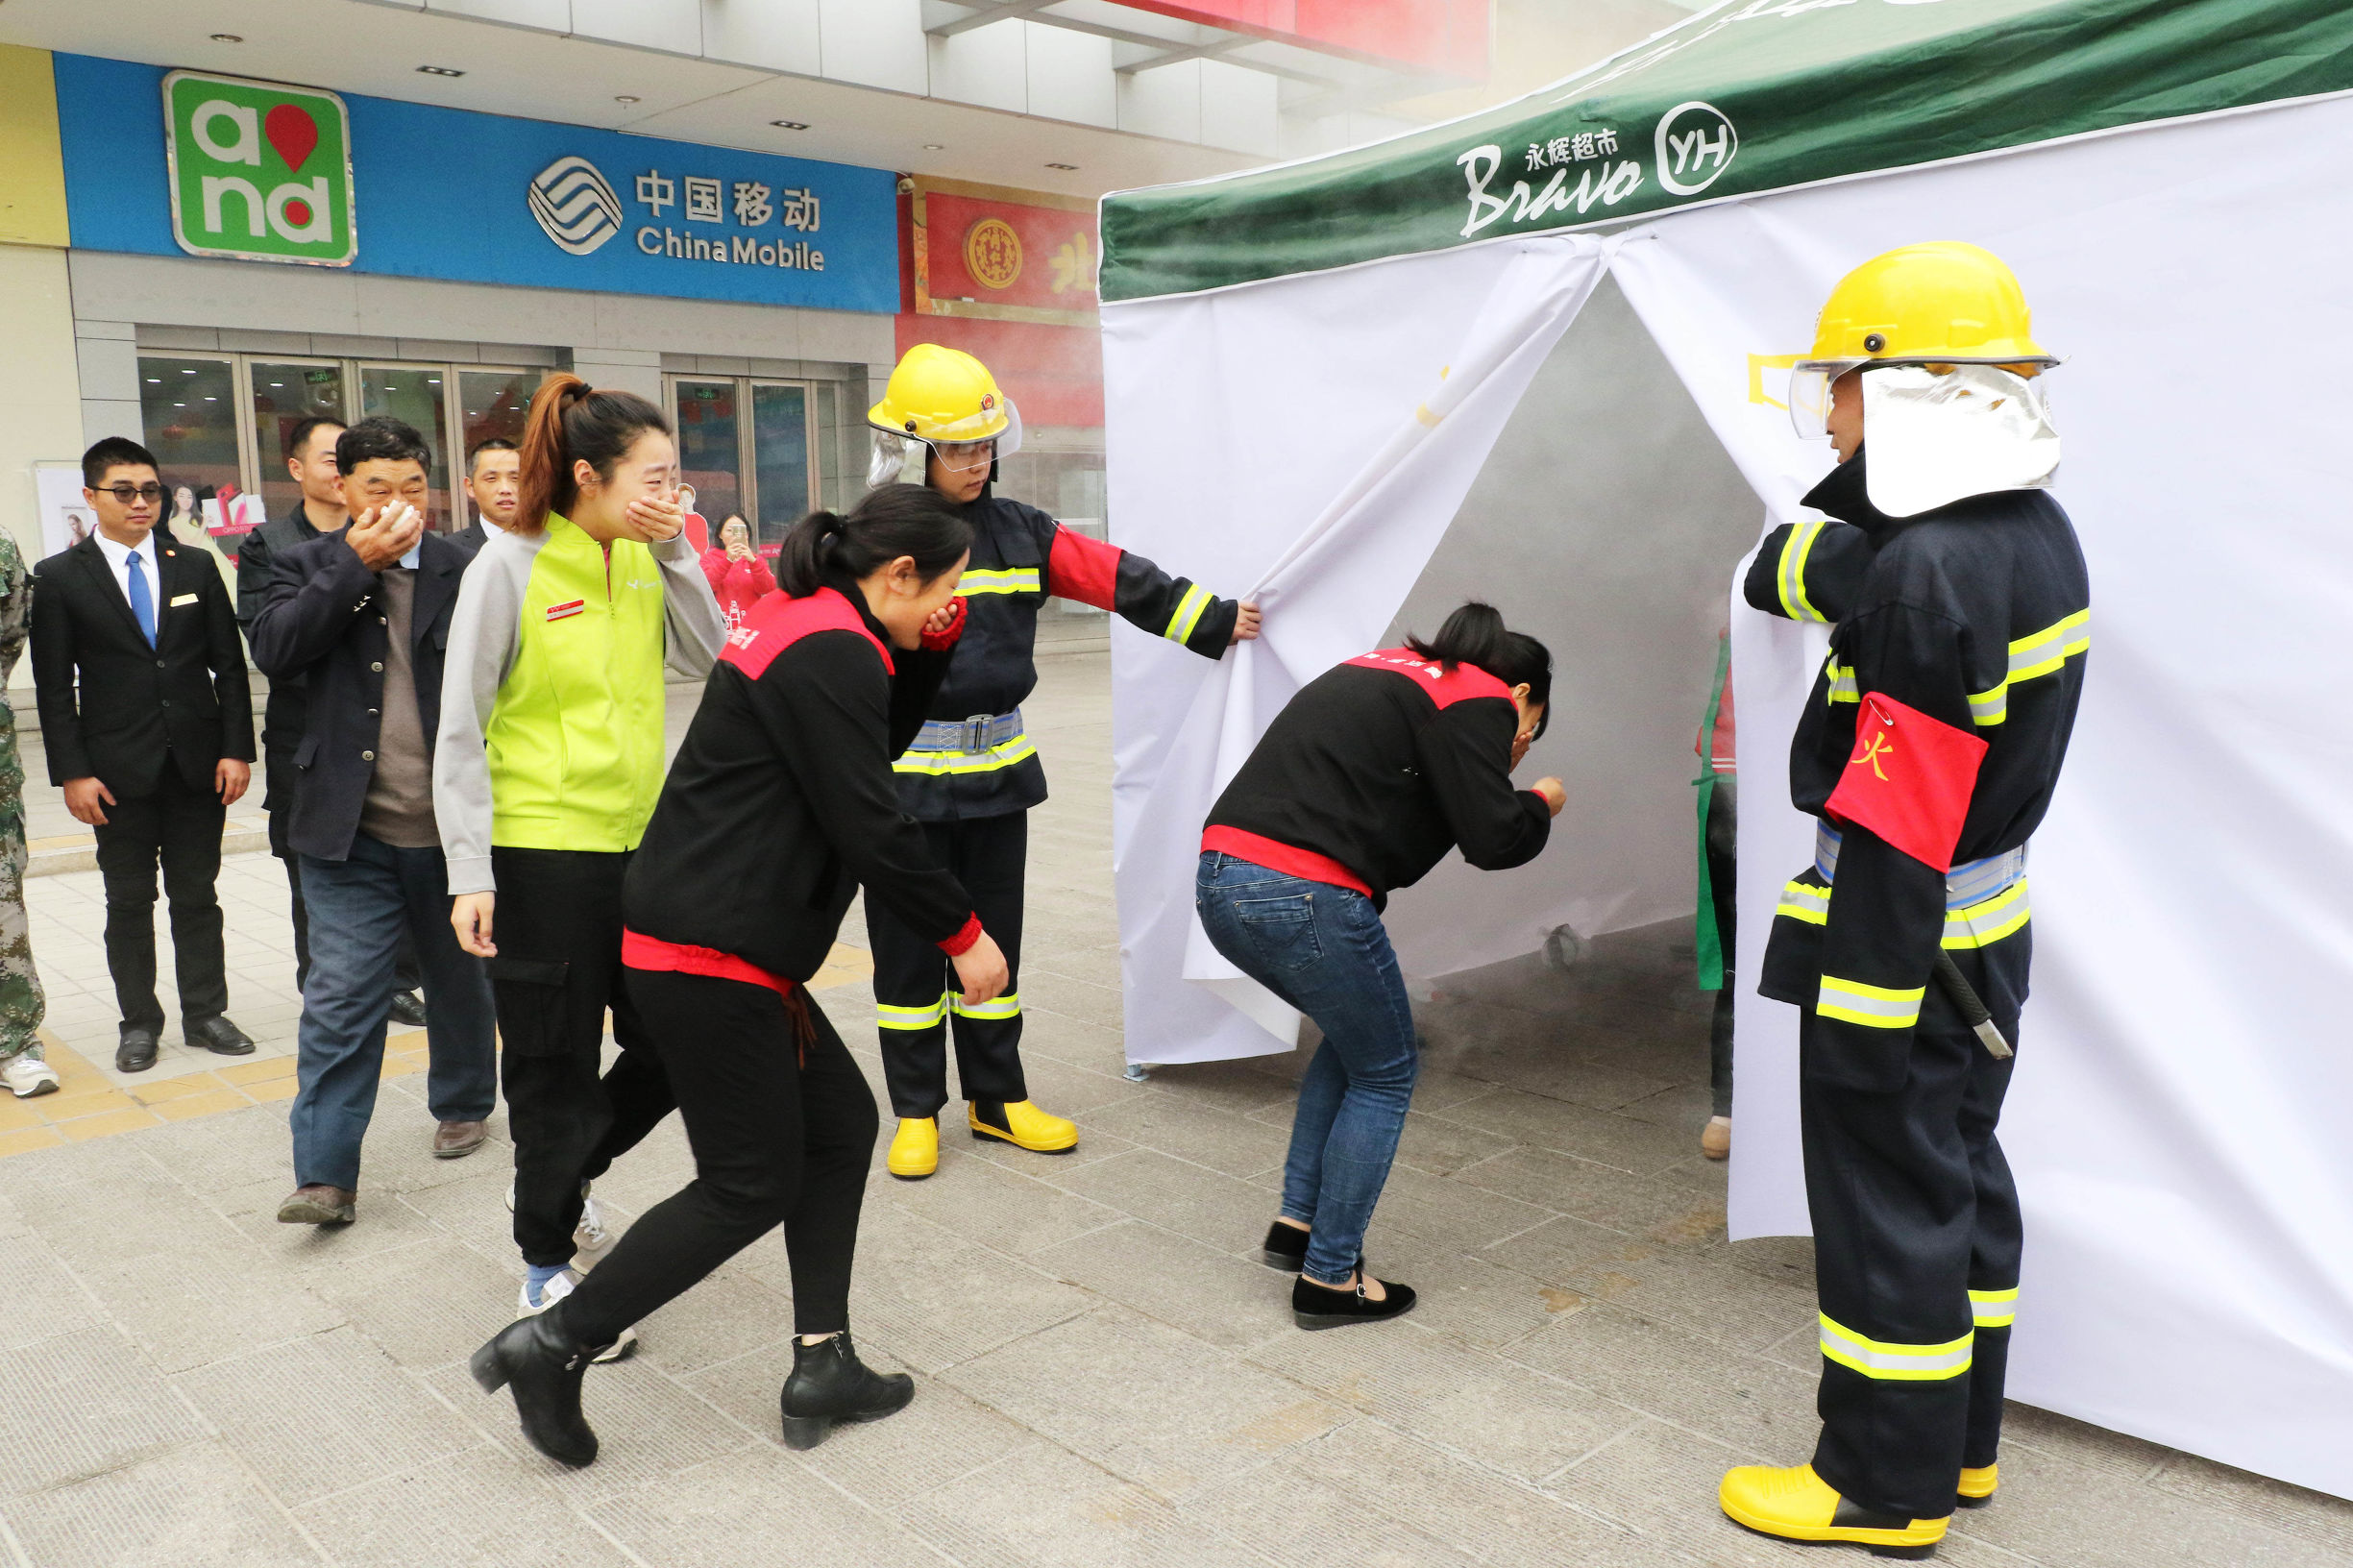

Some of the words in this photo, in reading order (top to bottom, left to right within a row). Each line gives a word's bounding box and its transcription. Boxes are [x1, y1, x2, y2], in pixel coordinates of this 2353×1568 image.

[1525, 128, 1619, 171] 永辉超市
[634, 168, 821, 233] 中国移动
[1457, 144, 1645, 238] Bravo
[1668, 124, 1728, 175] YH
[636, 226, 728, 263] China
[731, 235, 825, 272] Mobile
[1851, 730, 1894, 782] 火
